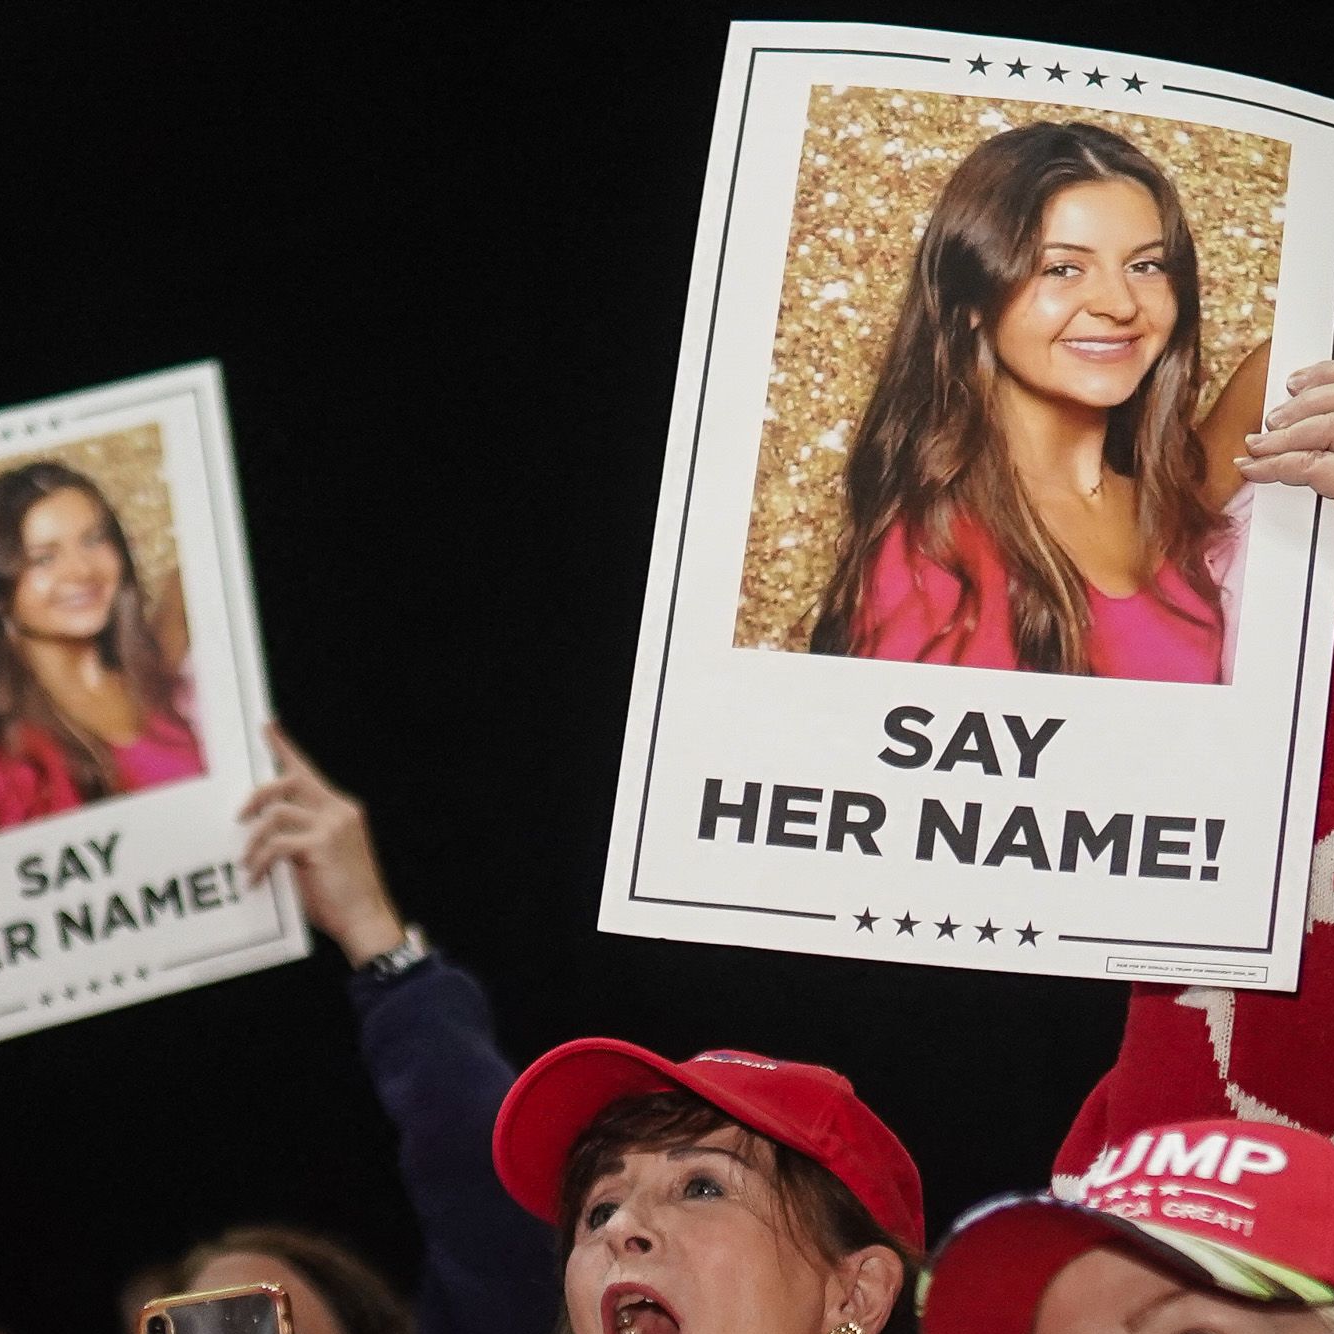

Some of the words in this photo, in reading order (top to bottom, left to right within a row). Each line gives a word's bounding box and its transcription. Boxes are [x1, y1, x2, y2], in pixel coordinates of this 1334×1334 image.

[878, 706, 1066, 779] SAY
[16, 832, 122, 898] SAY
[697, 778, 887, 857] HER
[915, 798, 1227, 882] NAME!
[53, 860, 243, 950] NAME!
